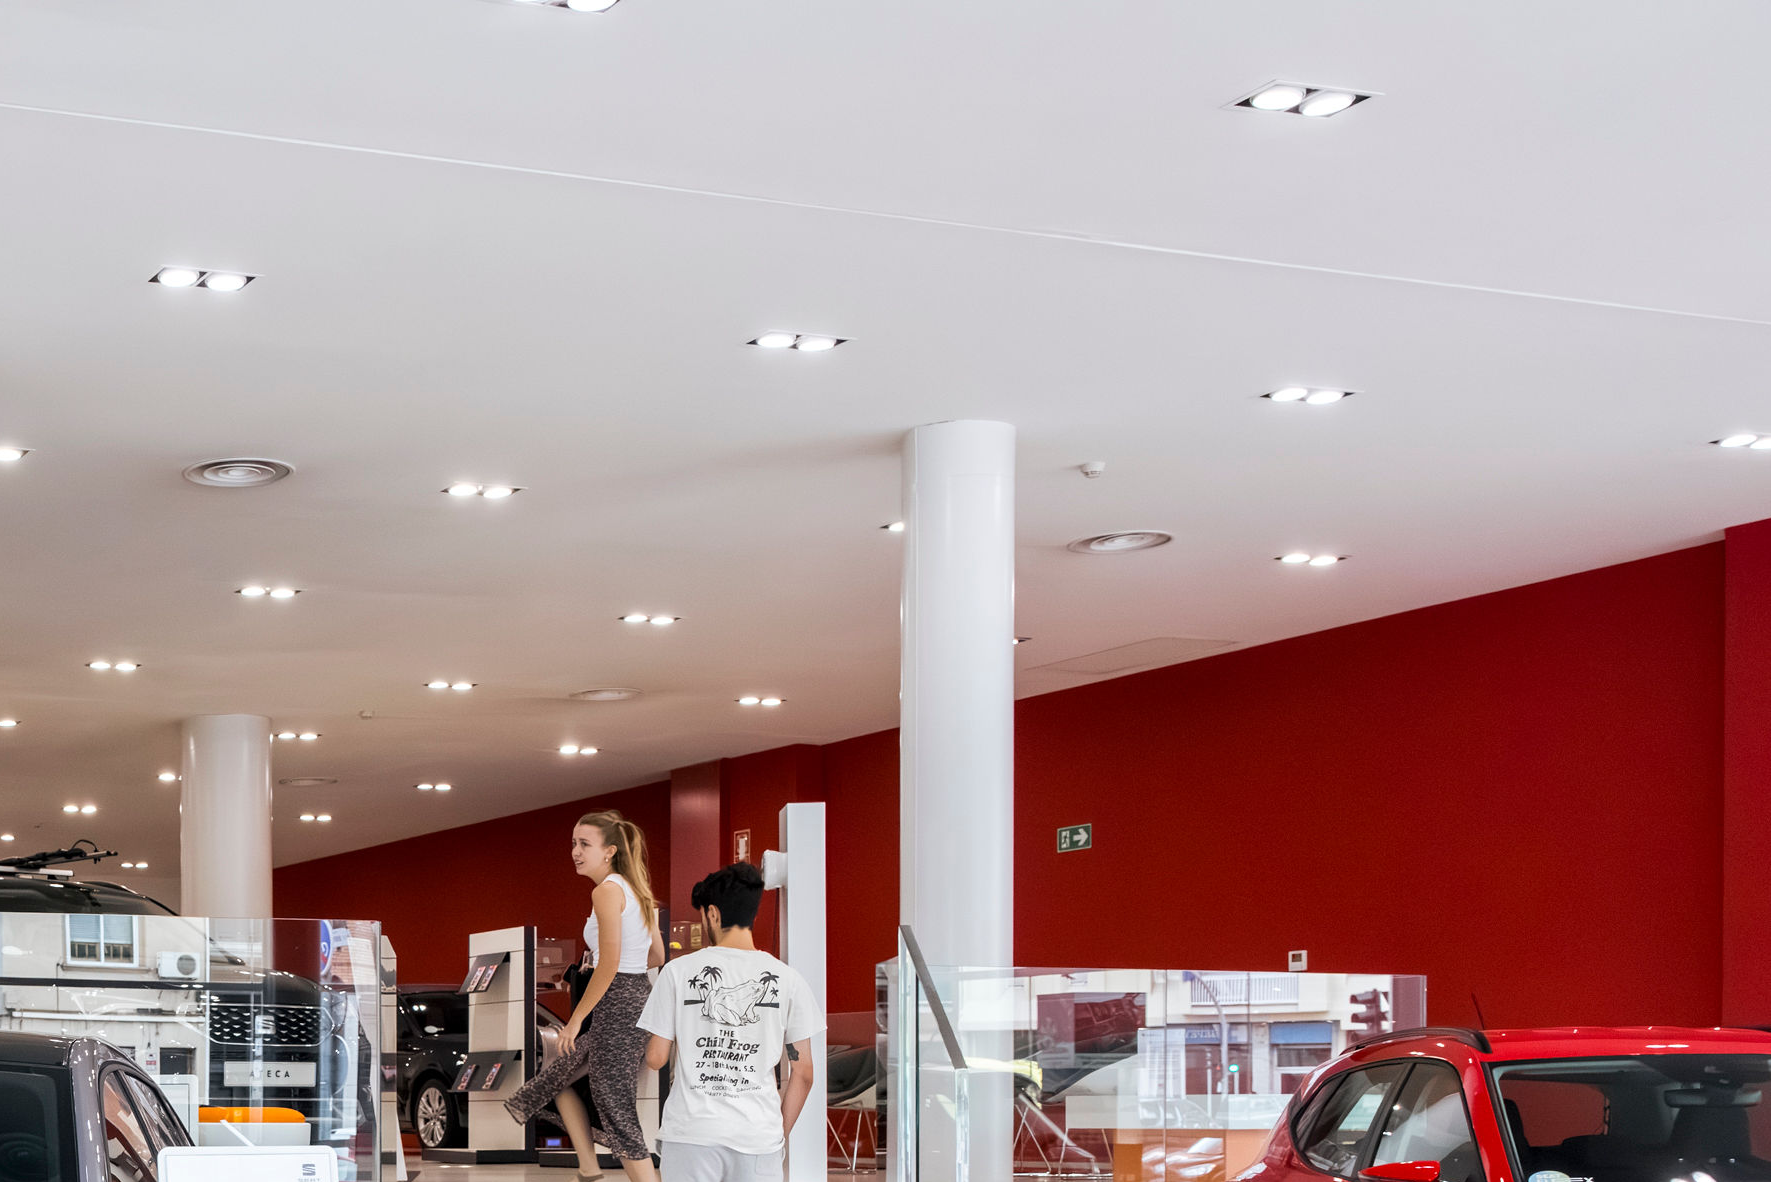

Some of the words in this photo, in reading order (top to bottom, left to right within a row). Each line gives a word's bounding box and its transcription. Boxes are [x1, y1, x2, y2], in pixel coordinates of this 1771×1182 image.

[719, 1029, 735, 1037] THE
[695, 1036, 725, 1048] Chill
[727, 1038, 760, 1054] Frog
[695, 1061, 706, 1069] 27
[249, 1069, 290, 1078] AECA
[741, 1077, 749, 1085] in
